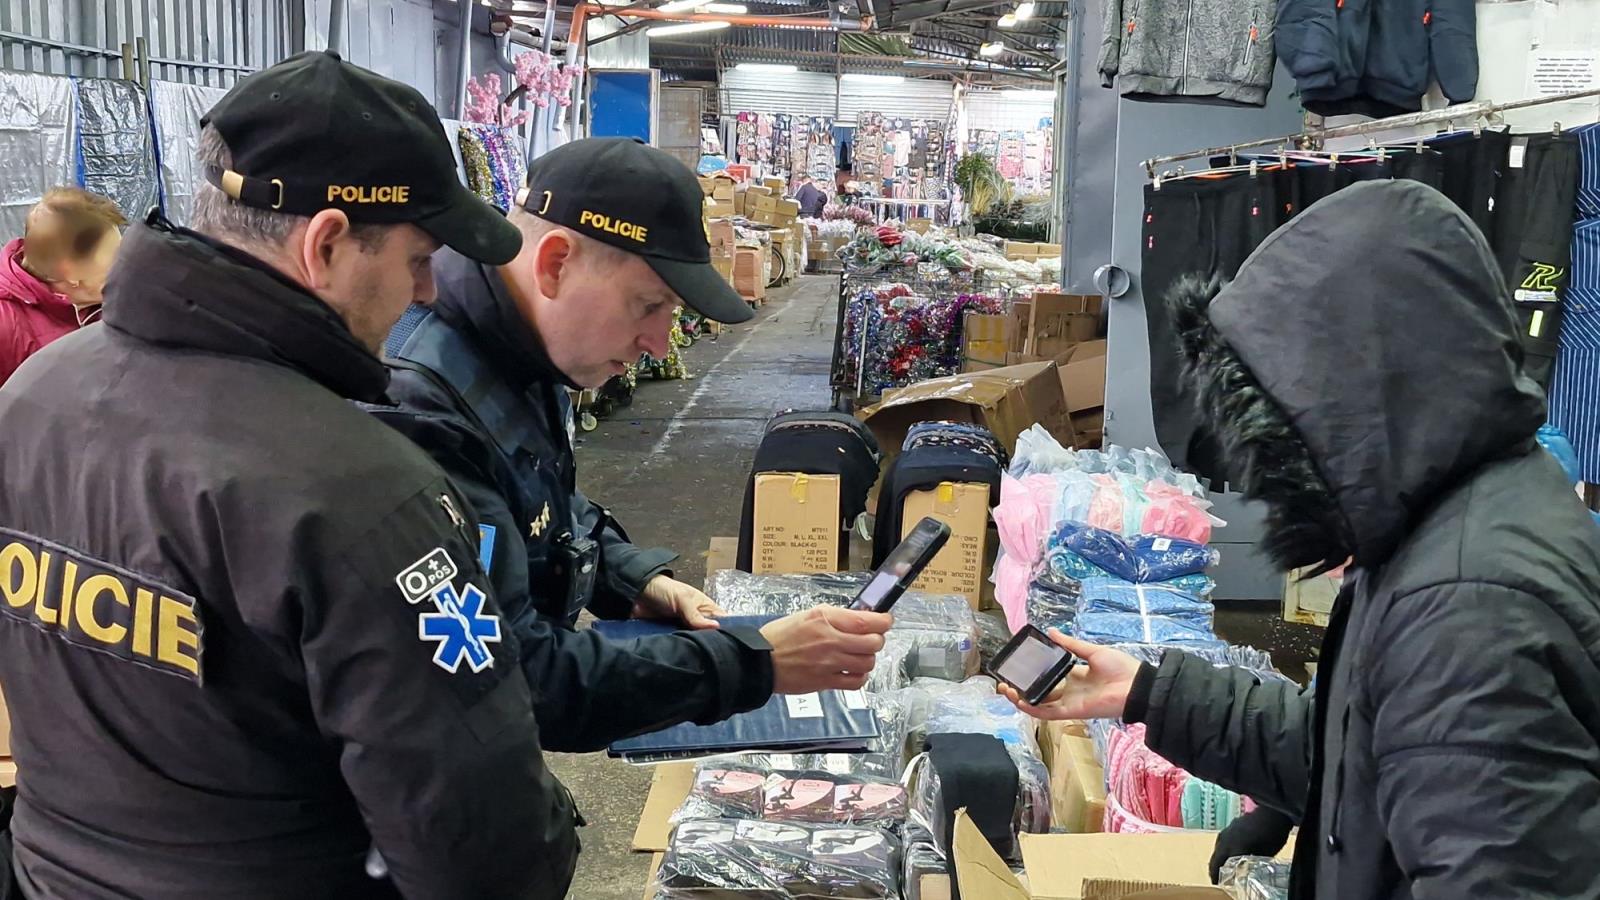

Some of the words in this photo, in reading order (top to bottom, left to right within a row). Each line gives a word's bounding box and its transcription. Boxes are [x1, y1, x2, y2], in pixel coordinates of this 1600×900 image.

[327, 185, 410, 203] POLICIE
[580, 210, 648, 243] POLICIE
[405, 571, 427, 594] O
[428, 565, 451, 585] POS
